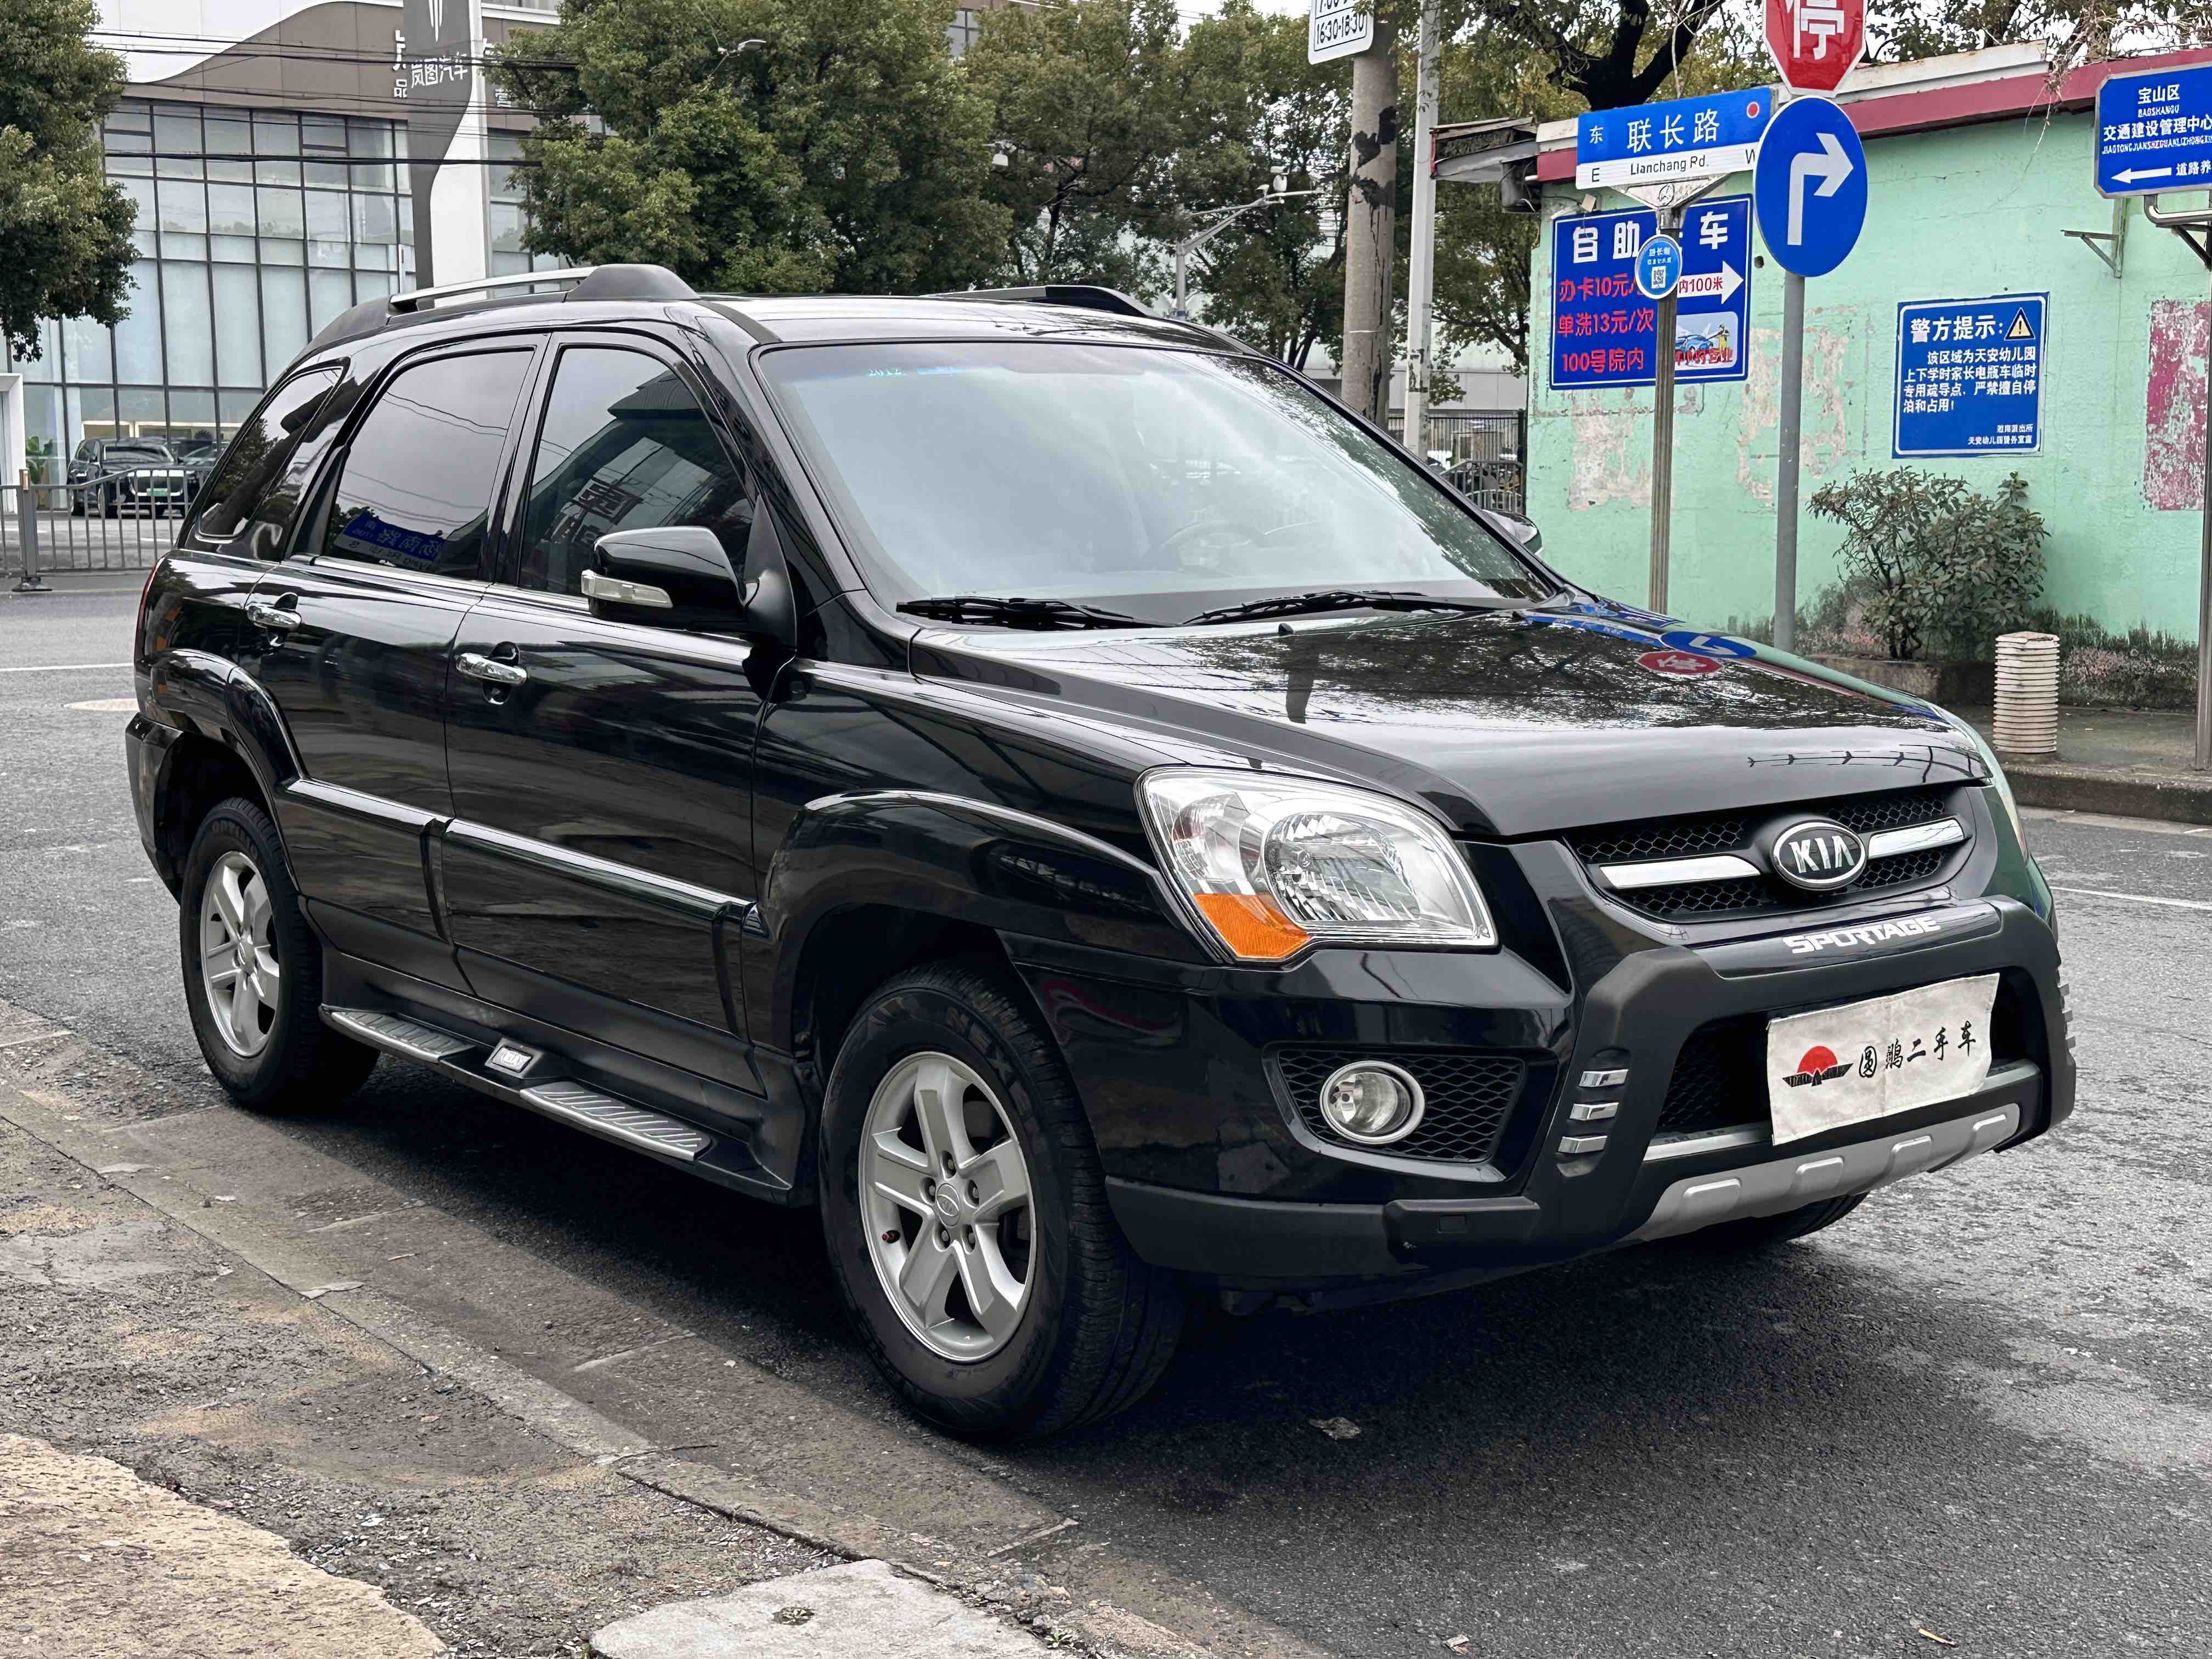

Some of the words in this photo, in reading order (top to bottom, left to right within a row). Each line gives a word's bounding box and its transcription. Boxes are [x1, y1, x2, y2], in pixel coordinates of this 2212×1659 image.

[411, 52, 468, 88] 岚图汽车
[2137, 83, 2180, 104] 宝山区
[1589, 126, 1604, 144] 东
[1627, 109, 1720, 153] 联长路
[2103, 114, 2212, 142] 交通建设管理中心
[1592, 168, 1600, 182] E
[1630, 159, 1686, 175] Lianchang
[1690, 155, 1709, 168] Rd.
[1559, 273, 1645, 302] 办卡10元/
[1557, 307, 1655, 338] 单洗13元/次
[1910, 315, 2004, 343] 警方提示：
[1562, 347, 1644, 374] 100号院内
[1927, 346, 2036, 365] 该区域为天安幼儿园
[1904, 363, 2037, 383] 上下学时家长电瓶车临时
[1788, 835, 1855, 874] KIA
[1782, 916, 1942, 955] SPORTAGE
